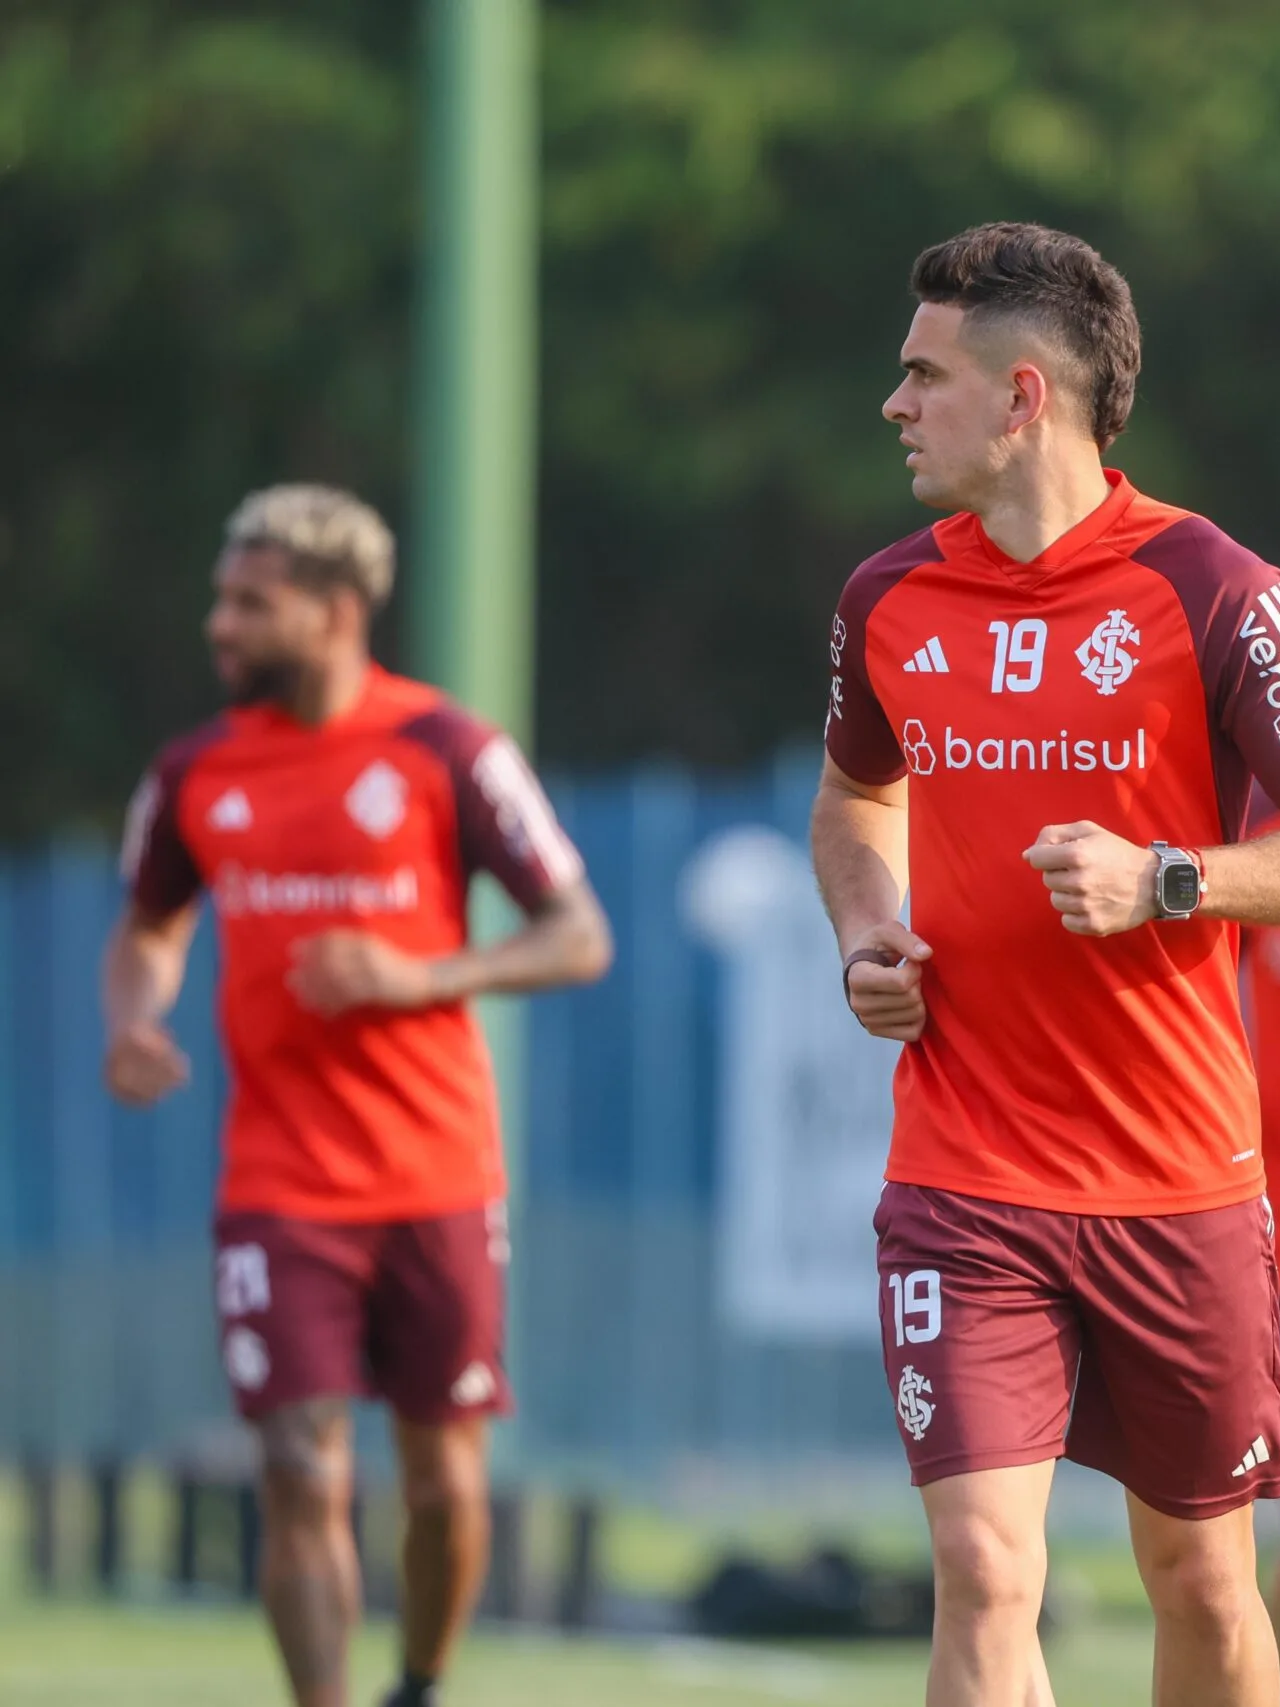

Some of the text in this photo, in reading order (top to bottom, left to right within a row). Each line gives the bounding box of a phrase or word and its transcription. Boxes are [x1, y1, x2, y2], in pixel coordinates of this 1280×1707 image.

[988, 618, 1048, 694] 19
[945, 726, 1146, 771] banrisul
[888, 1269, 942, 1347] 19
